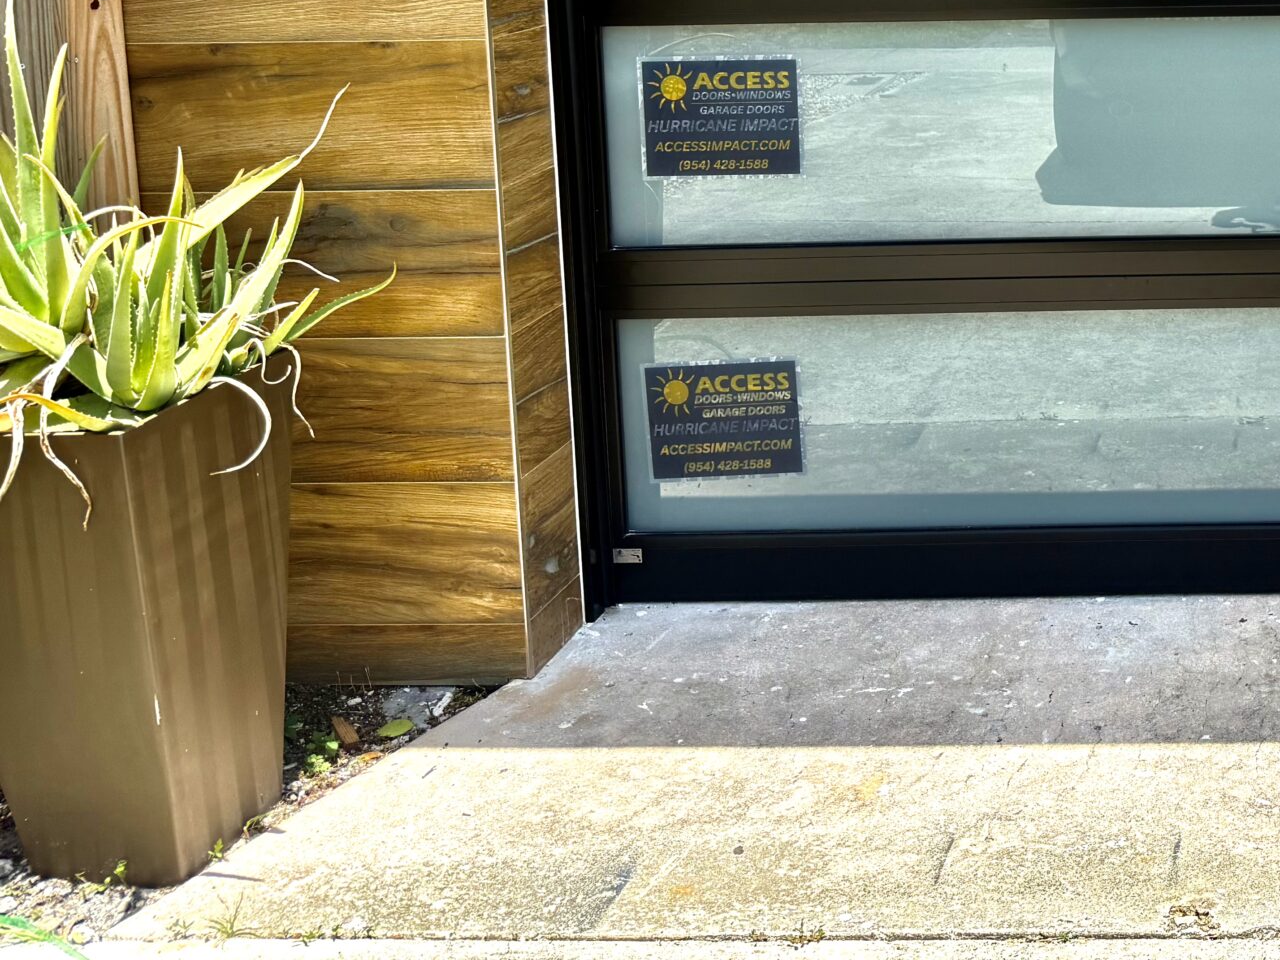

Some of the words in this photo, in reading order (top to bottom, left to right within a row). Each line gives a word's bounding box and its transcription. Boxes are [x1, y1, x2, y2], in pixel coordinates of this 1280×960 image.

[692, 71, 790, 90] ACCESS
[700, 105, 744, 115] GARAGE
[746, 105, 785, 114] DOORS
[648, 119, 737, 133] HURRICANE
[740, 118, 798, 132] IMPACT
[654, 140, 791, 152] ACCESSIMPACT.COM
[679, 160, 711, 171] (954)
[714, 158, 769, 170] 428-1588
[695, 372, 790, 394] ACCESS
[702, 407, 746, 418] GARAGE
[748, 405, 786, 416] DOORS
[654, 422, 739, 437] HURRICANE
[742, 417, 798, 433] IMPACT
[660, 438, 792, 456] ACCESSIMPACT.COM
[684, 461, 715, 474] (954)
[718, 458, 772, 470] 428-1588
